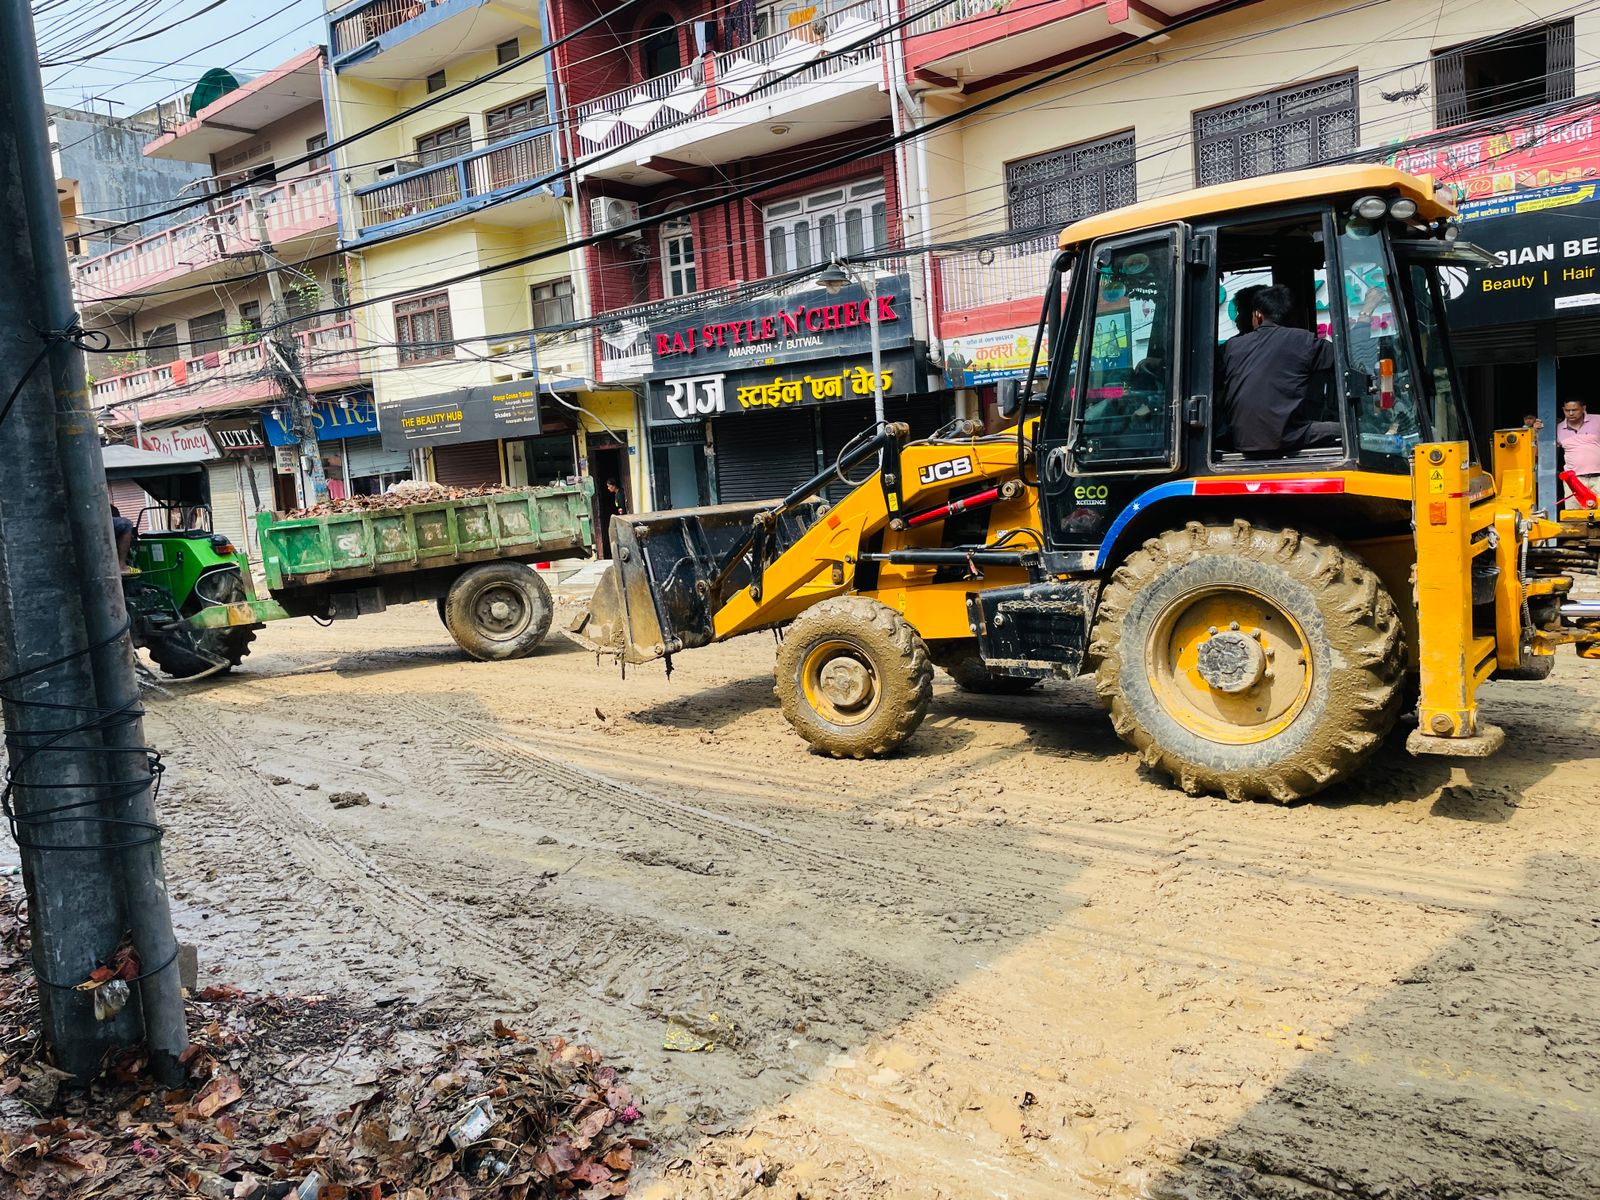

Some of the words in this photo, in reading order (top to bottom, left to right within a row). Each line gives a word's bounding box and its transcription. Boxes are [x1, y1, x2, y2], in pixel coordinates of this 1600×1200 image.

[1477, 243, 1555, 271] SIAN
[1563, 236, 1600, 258] BE
[1482, 275, 1535, 292] Beauty
[1563, 265, 1596, 281] Hair
[655, 326, 696, 355] RAJ
[702, 316, 776, 348] STYLE
[805, 294, 899, 333] CHECK
[728, 342, 772, 358] AMARPATH
[786, 335, 823, 350] BUTWAL
[975, 342, 1014, 360] कलश
[664, 373, 727, 418] राज
[737, 376, 804, 408] स्टाईल
[401, 417, 415, 428] THE
[416, 412, 445, 426] BEAUTY
[446, 410, 463, 422] HUB
[494, 411, 511, 419] Shades
[171, 429, 210, 455] Fancy
[216, 429, 264, 448] JUTTA
[920, 456, 972, 485] JCB
[1074, 485, 1109, 500] eco
